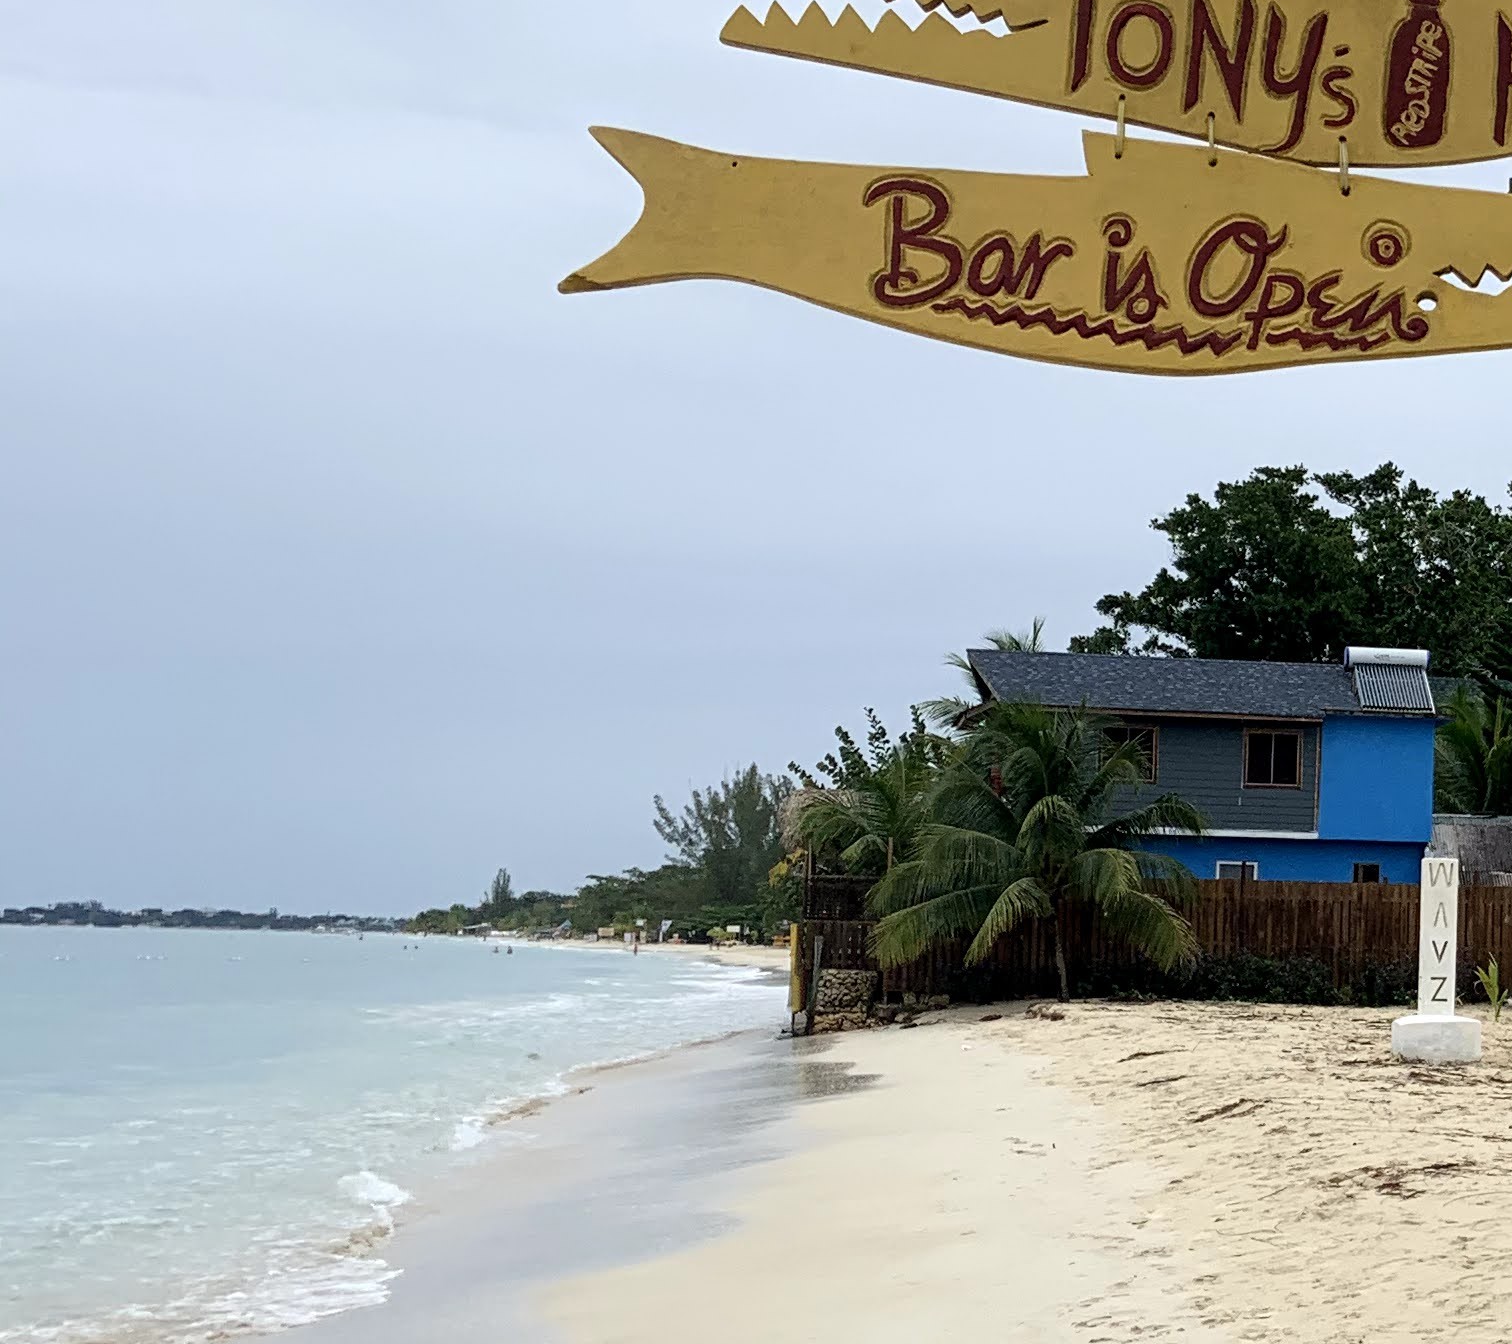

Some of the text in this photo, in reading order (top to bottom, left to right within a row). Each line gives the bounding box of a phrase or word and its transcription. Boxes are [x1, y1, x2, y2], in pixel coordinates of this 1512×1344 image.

[863, 176, 1430, 351] Bar is Open
